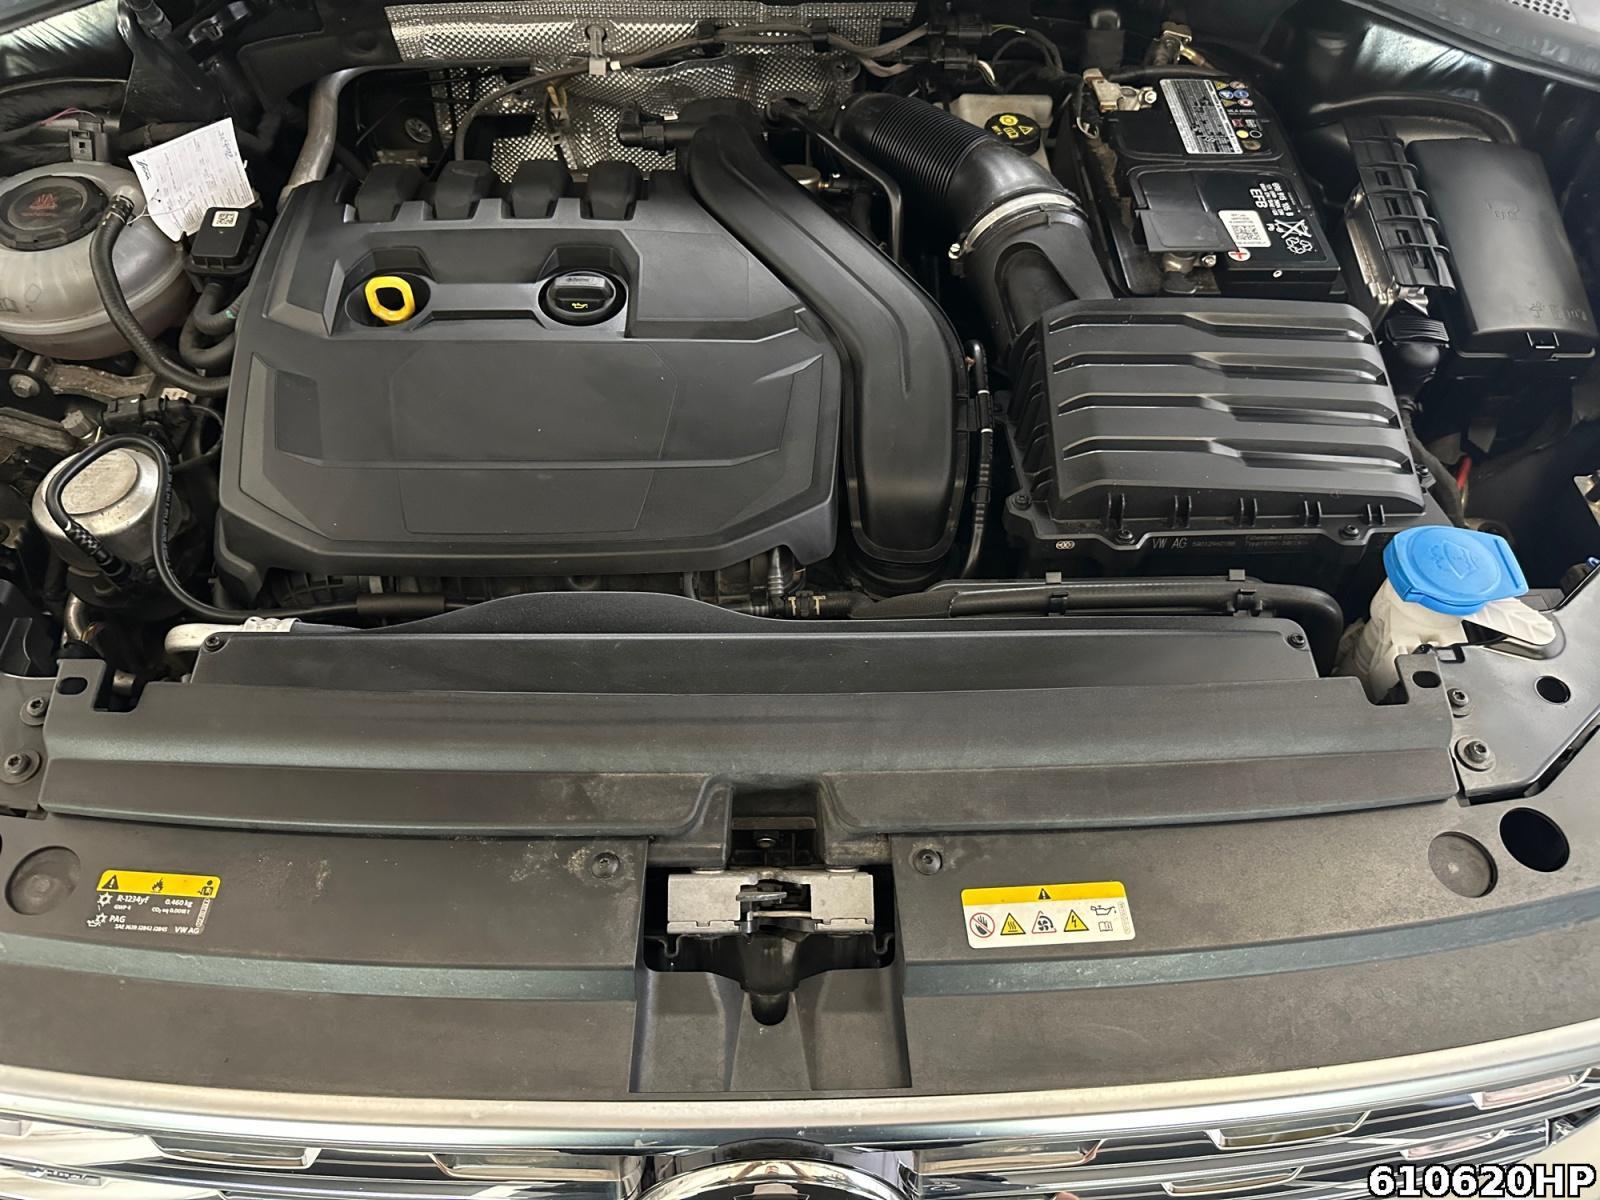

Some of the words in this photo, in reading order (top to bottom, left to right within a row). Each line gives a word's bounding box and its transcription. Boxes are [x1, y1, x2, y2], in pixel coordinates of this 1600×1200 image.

[1249, 188, 1269, 208] EFB
[1152, 537, 1168, 549] VW
[1170, 537, 1188, 549] AG
[116, 894, 150, 906] R-1234yf
[109, 914, 127, 923] PAG
[174, 925, 188, 934] VW
[187, 926, 200, 934] AG
